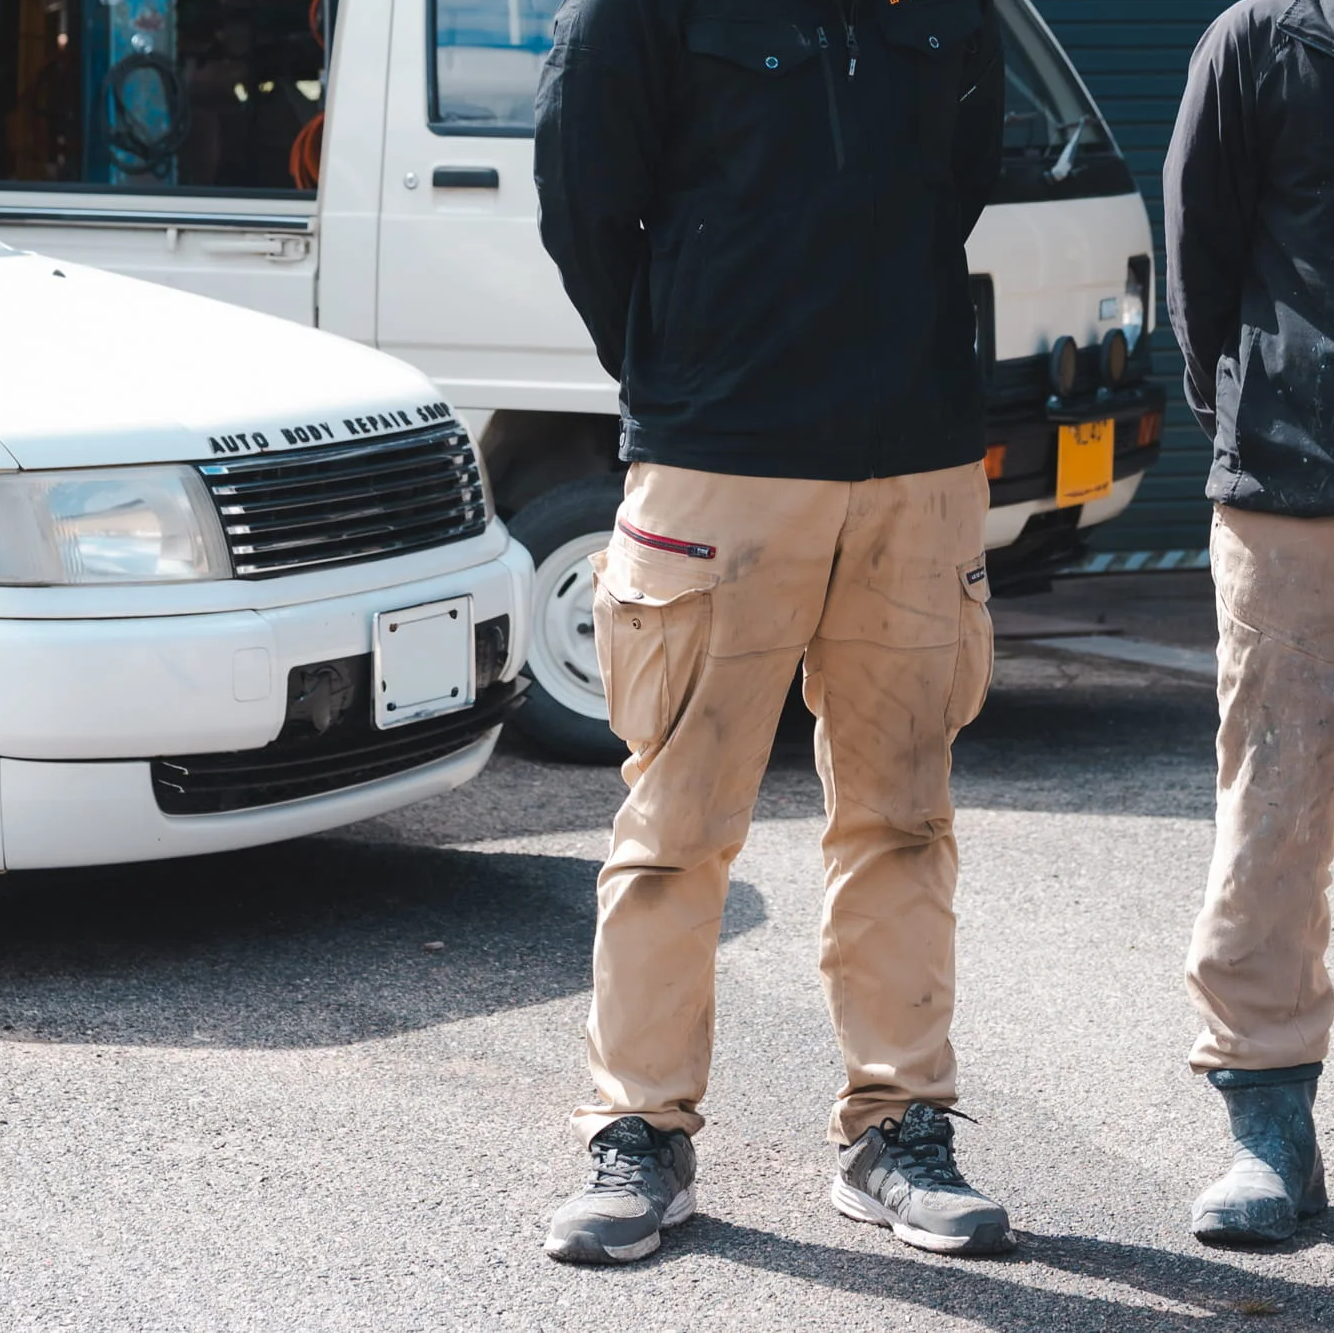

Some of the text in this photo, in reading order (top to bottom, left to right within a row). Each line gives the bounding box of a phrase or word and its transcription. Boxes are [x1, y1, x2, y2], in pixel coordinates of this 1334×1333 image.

[207, 401, 454, 454] AUTO BODY REPAIR SHOP
